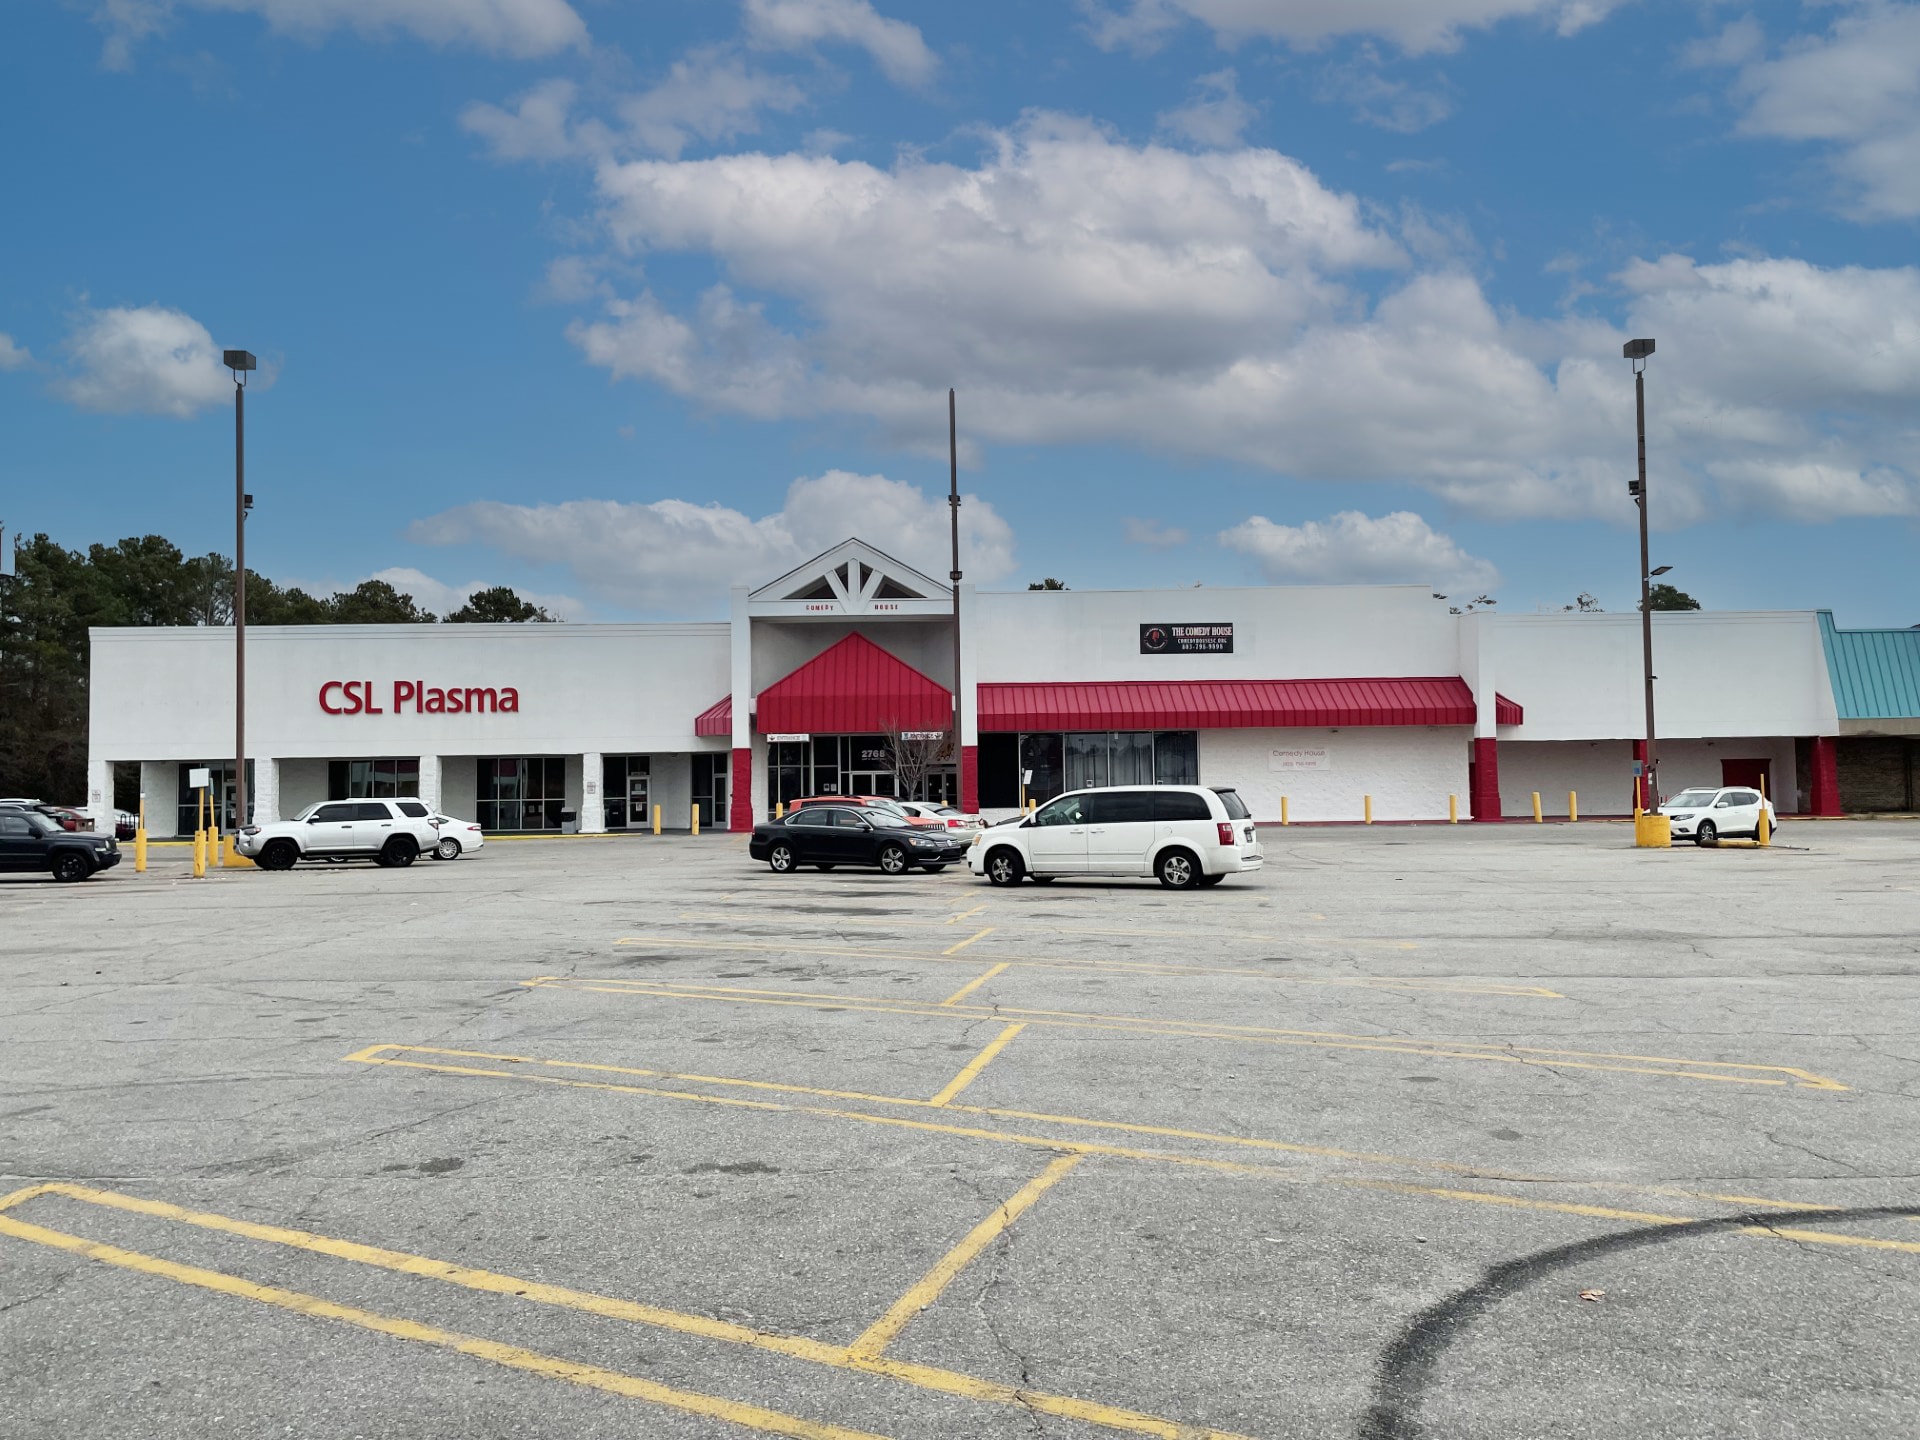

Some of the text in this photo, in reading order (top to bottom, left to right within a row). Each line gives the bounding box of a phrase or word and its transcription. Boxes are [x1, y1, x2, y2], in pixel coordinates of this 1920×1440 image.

[1171, 627, 1185, 636] THE
[1185, 627, 1211, 636] COMEDY
[1211, 627, 1233, 636] HOUSE
[318, 680, 520, 715] CSL Plasma
[861, 749, 885, 758] 2768
